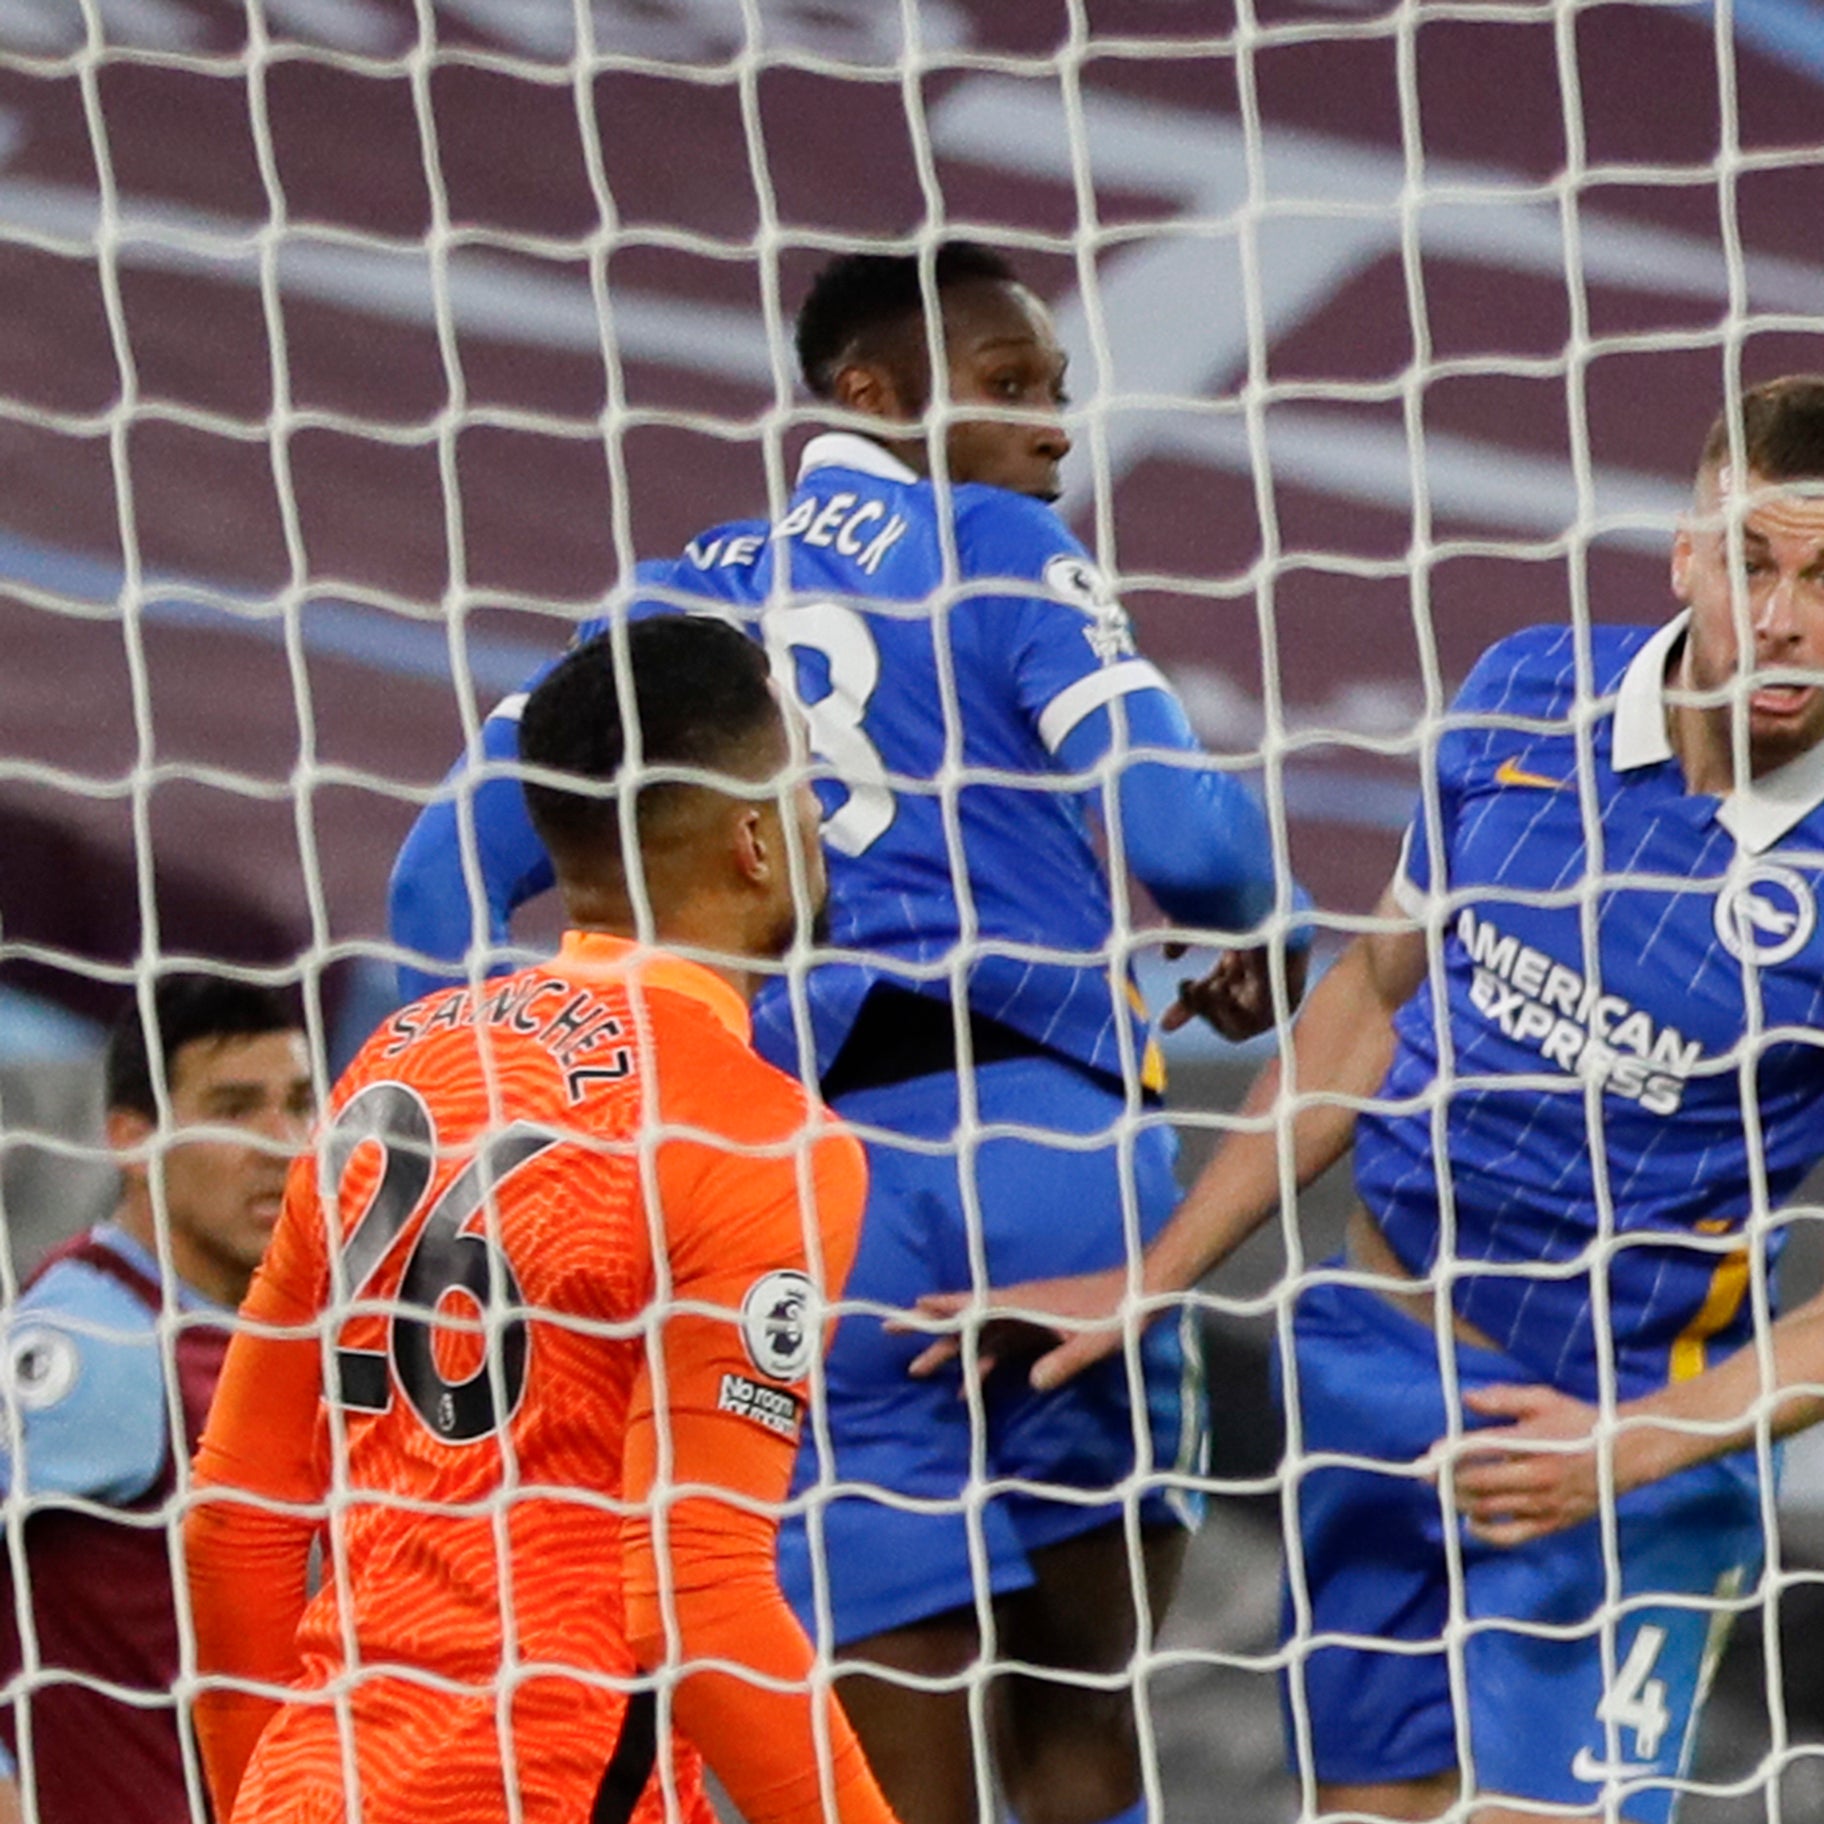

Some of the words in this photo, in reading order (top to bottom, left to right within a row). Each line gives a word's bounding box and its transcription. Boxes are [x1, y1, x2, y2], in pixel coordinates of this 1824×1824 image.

[686, 601, 897, 857] 8
[382, 973, 633, 1107] SANCHEZ
[1456, 908, 1703, 1078] AMERICAN
[1468, 967, 1687, 1116] EXPRESS
[321, 1080, 566, 1446] 26
[721, 1373, 755, 1401] No
[1595, 1624, 1672, 1761] 4
